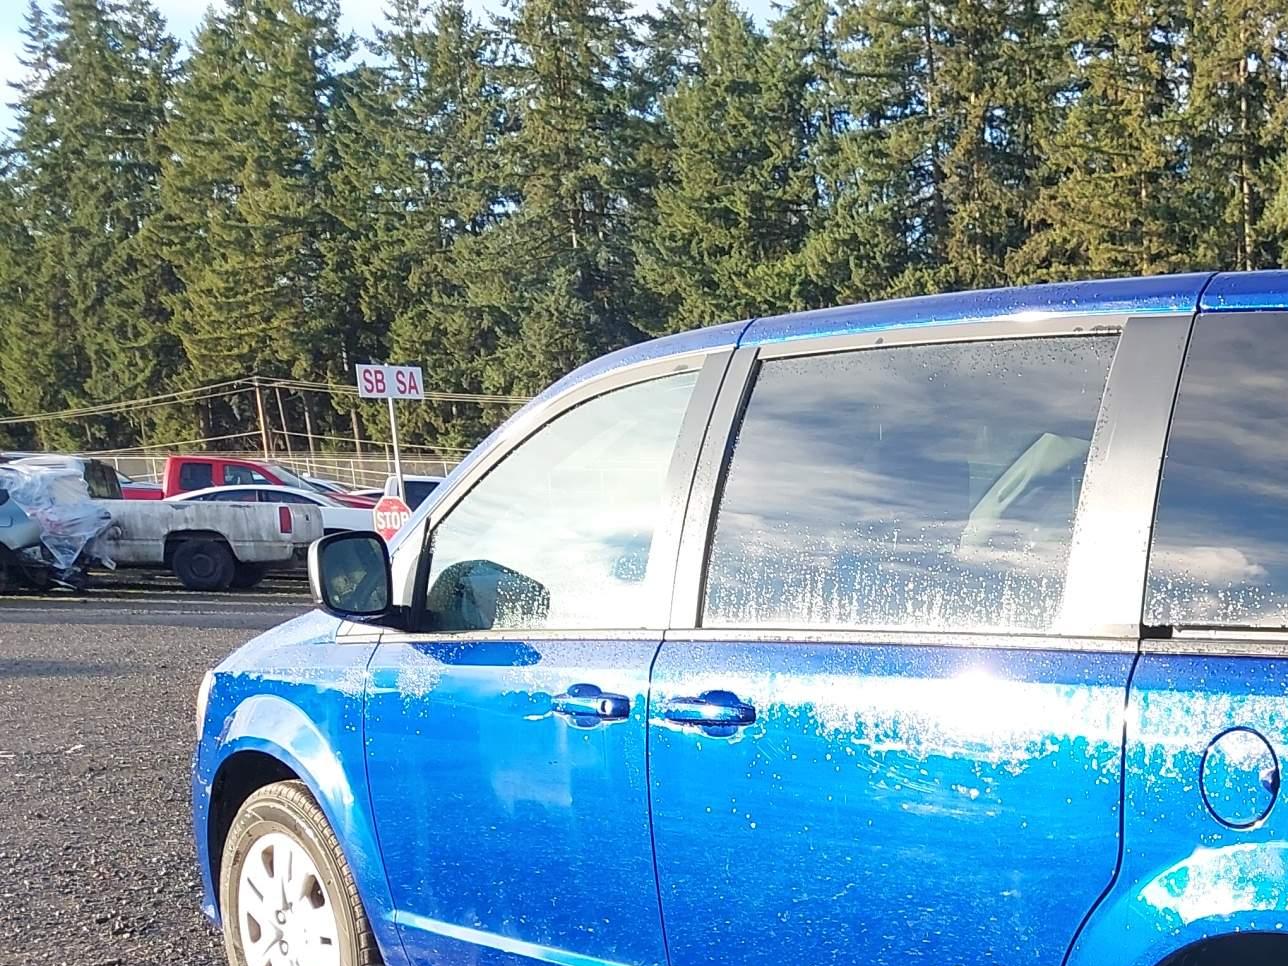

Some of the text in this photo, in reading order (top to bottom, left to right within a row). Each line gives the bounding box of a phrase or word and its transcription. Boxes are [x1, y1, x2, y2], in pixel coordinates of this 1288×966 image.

[363, 368, 419, 394] SB SA
[376, 511, 409, 530] STOP
